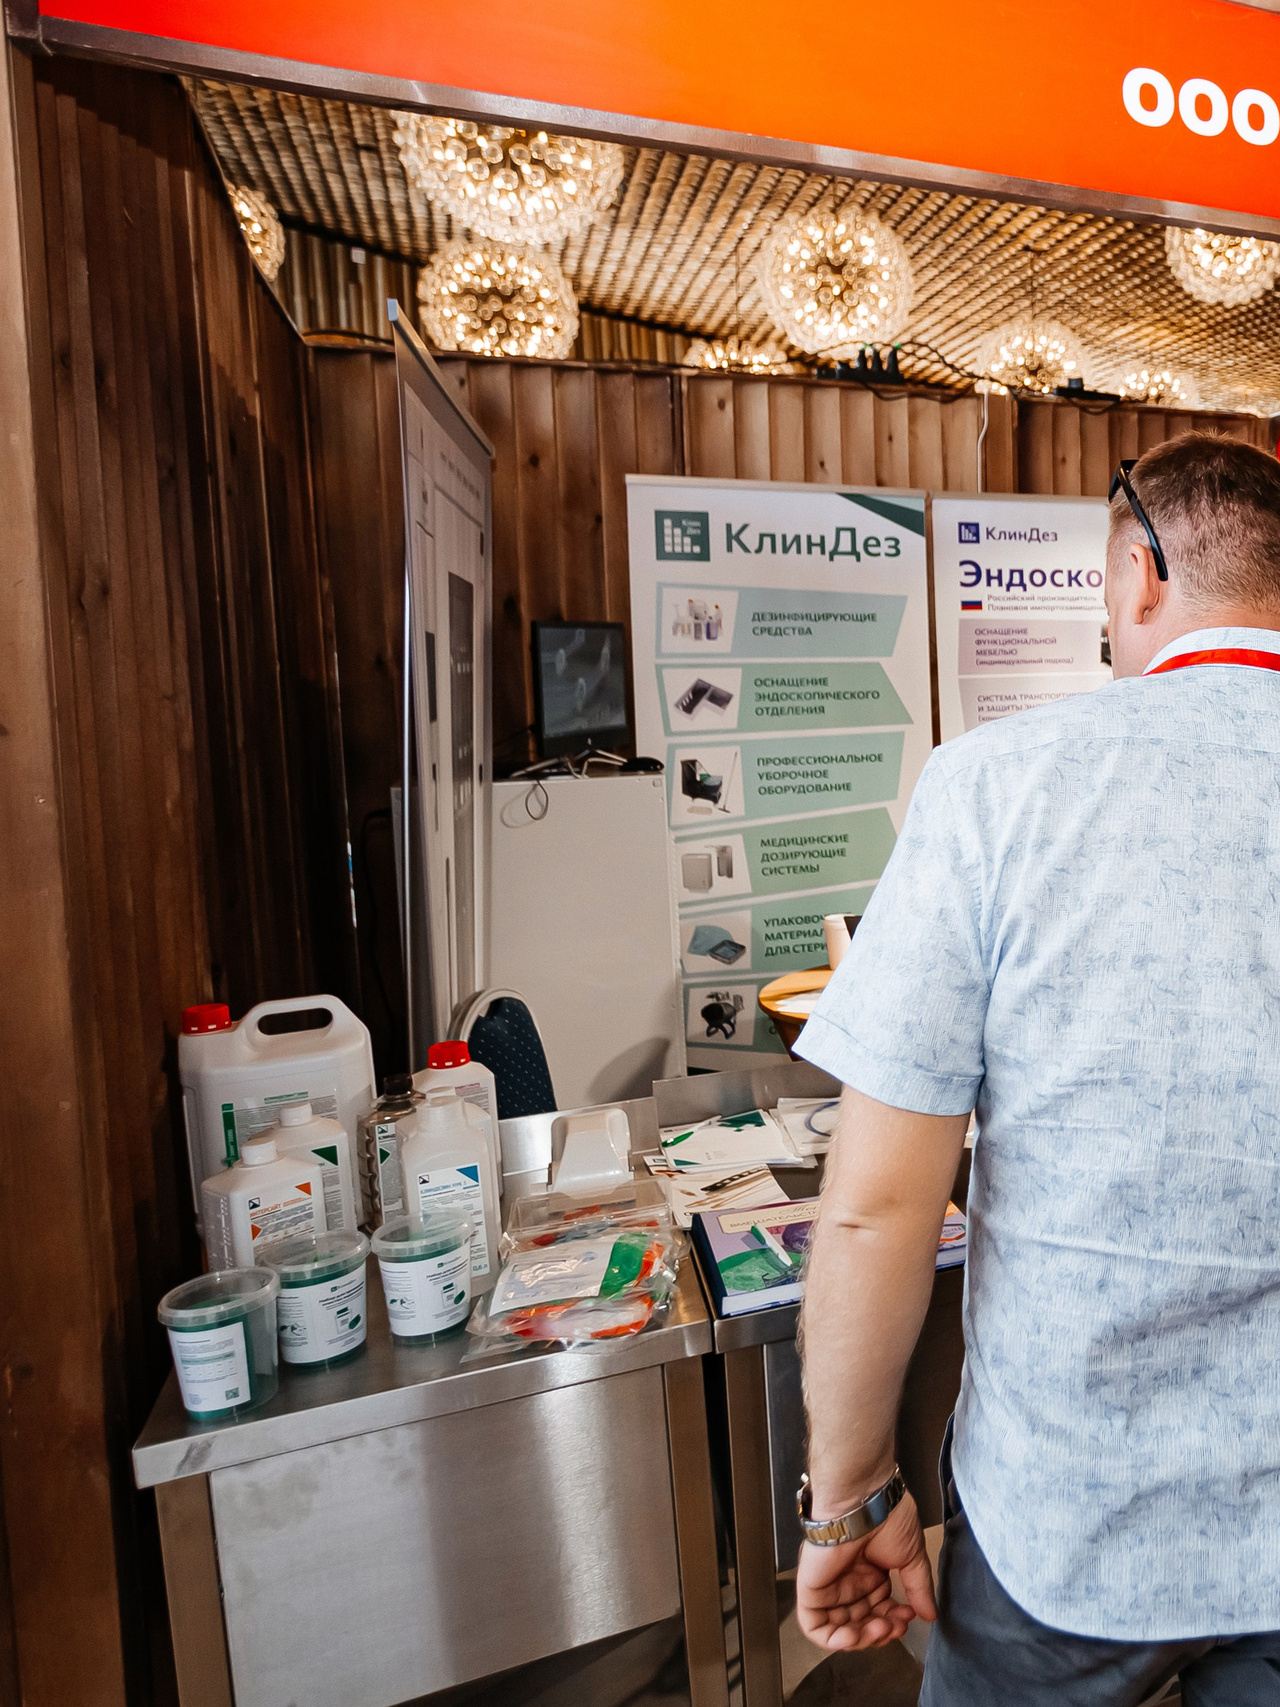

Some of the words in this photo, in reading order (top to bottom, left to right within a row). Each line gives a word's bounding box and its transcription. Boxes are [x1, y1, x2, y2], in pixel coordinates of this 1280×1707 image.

[1121, 66, 1280, 147] ООО
[985, 527, 1058, 543] КлинДез
[725, 523, 901, 562] КлинДез
[958, 560, 1103, 592] Эндоско
[751, 612, 877, 623] ДЕЗИНФИЦИРУЮЩИЕ
[752, 626, 813, 637] СРЕДСТВА
[974, 628, 1028, 636] ОСНАЩЕНИЕ
[974, 637, 1057, 646] ФУНКЦИОНАЛЬНОЙ
[754, 677, 829, 687] ОСНАЩЕНИЕ
[755, 690, 880, 702] ЭНДОСКОПИЧЕСКОГО
[977, 694, 1017, 702] СИСТЕМА
[755, 705, 826, 717] ОТДЕЛЕНИЯ
[986, 704, 1022, 712] ЗАЩИТЫ
[757, 753, 883, 767] ПРОФЕССИОНАЛЬНОЕ
[757, 769, 829, 781] УБОРОЧНОЕ
[758, 782, 852, 795] ОБОРУДОВАНИЕ
[760, 834, 849, 847] МЕДИЦИНСКИЕ
[760, 848, 847, 863] ДОЗИРУЮЩИЕ
[761, 864, 820, 876] СИСТЕМЫ
[765, 946, 791, 957] ДЛЯ
